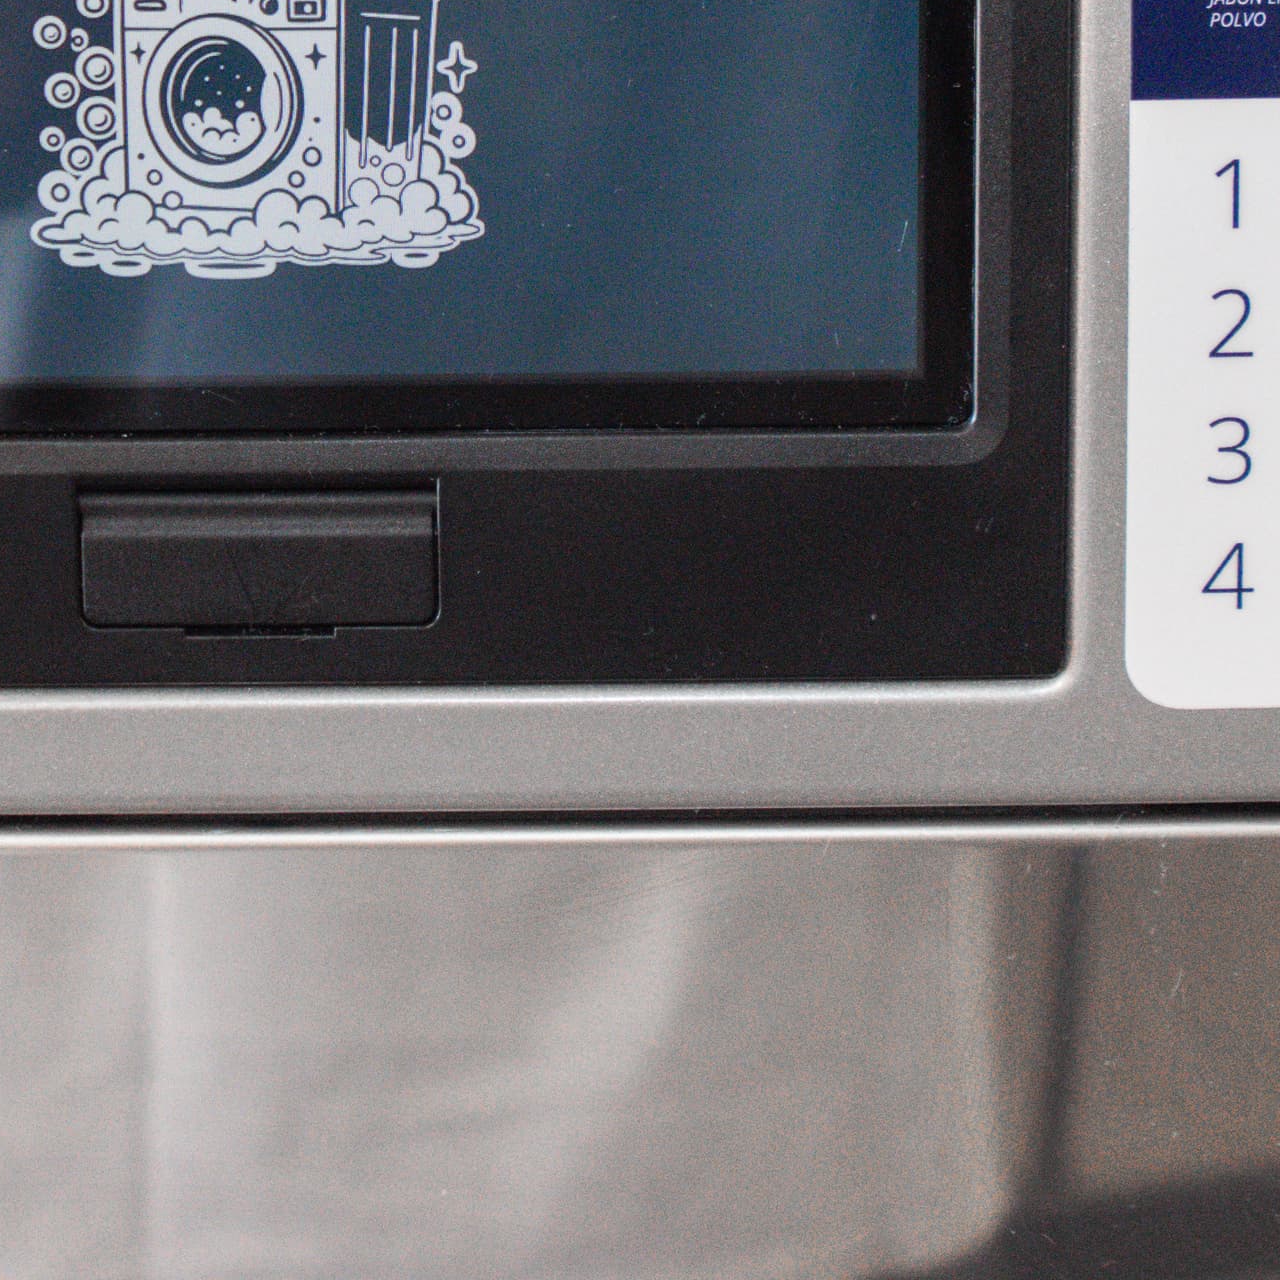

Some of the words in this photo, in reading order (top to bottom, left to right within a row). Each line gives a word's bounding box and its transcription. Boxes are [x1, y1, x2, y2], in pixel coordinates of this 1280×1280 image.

[1210, 11, 1267, 27] POLVO
[1216, 159, 1240, 229] 1
[1209, 289, 1253, 358] 2
[1208, 417, 1251, 484] 3
[1202, 543, 1254, 609] 4
